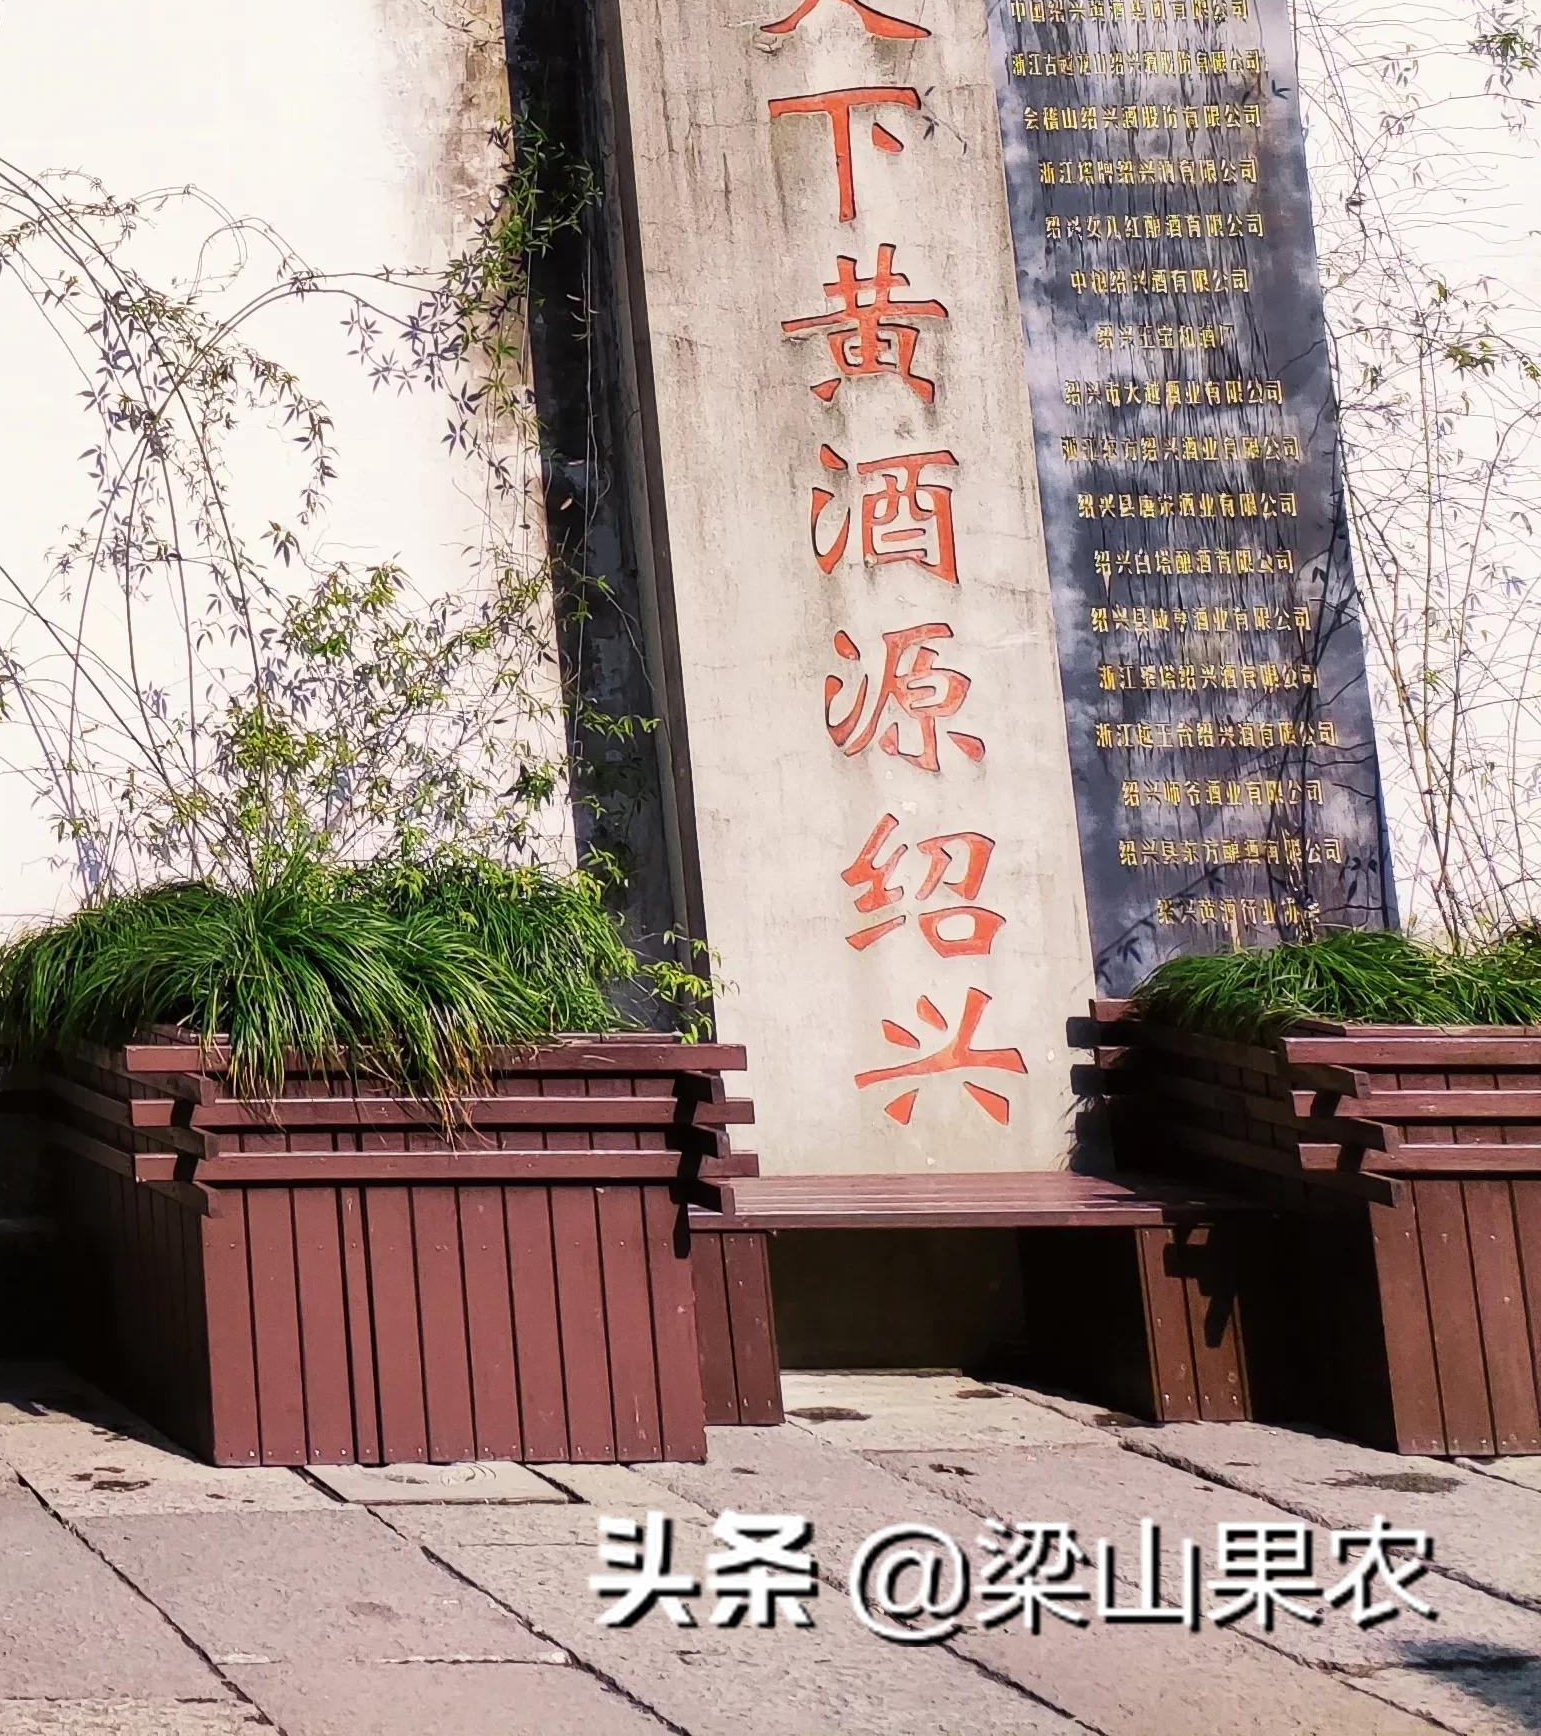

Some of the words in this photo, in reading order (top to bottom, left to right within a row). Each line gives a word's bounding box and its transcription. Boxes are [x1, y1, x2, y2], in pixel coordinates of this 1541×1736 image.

[1023, 104, 1261, 131] 会稽山绍兴酒股份有限公司
[1039, 156, 1257, 184] 浙江塔牌绍兴酒有限公司
[1045, 213, 1263, 240] 绍兴女儿红酿酒有限公司
